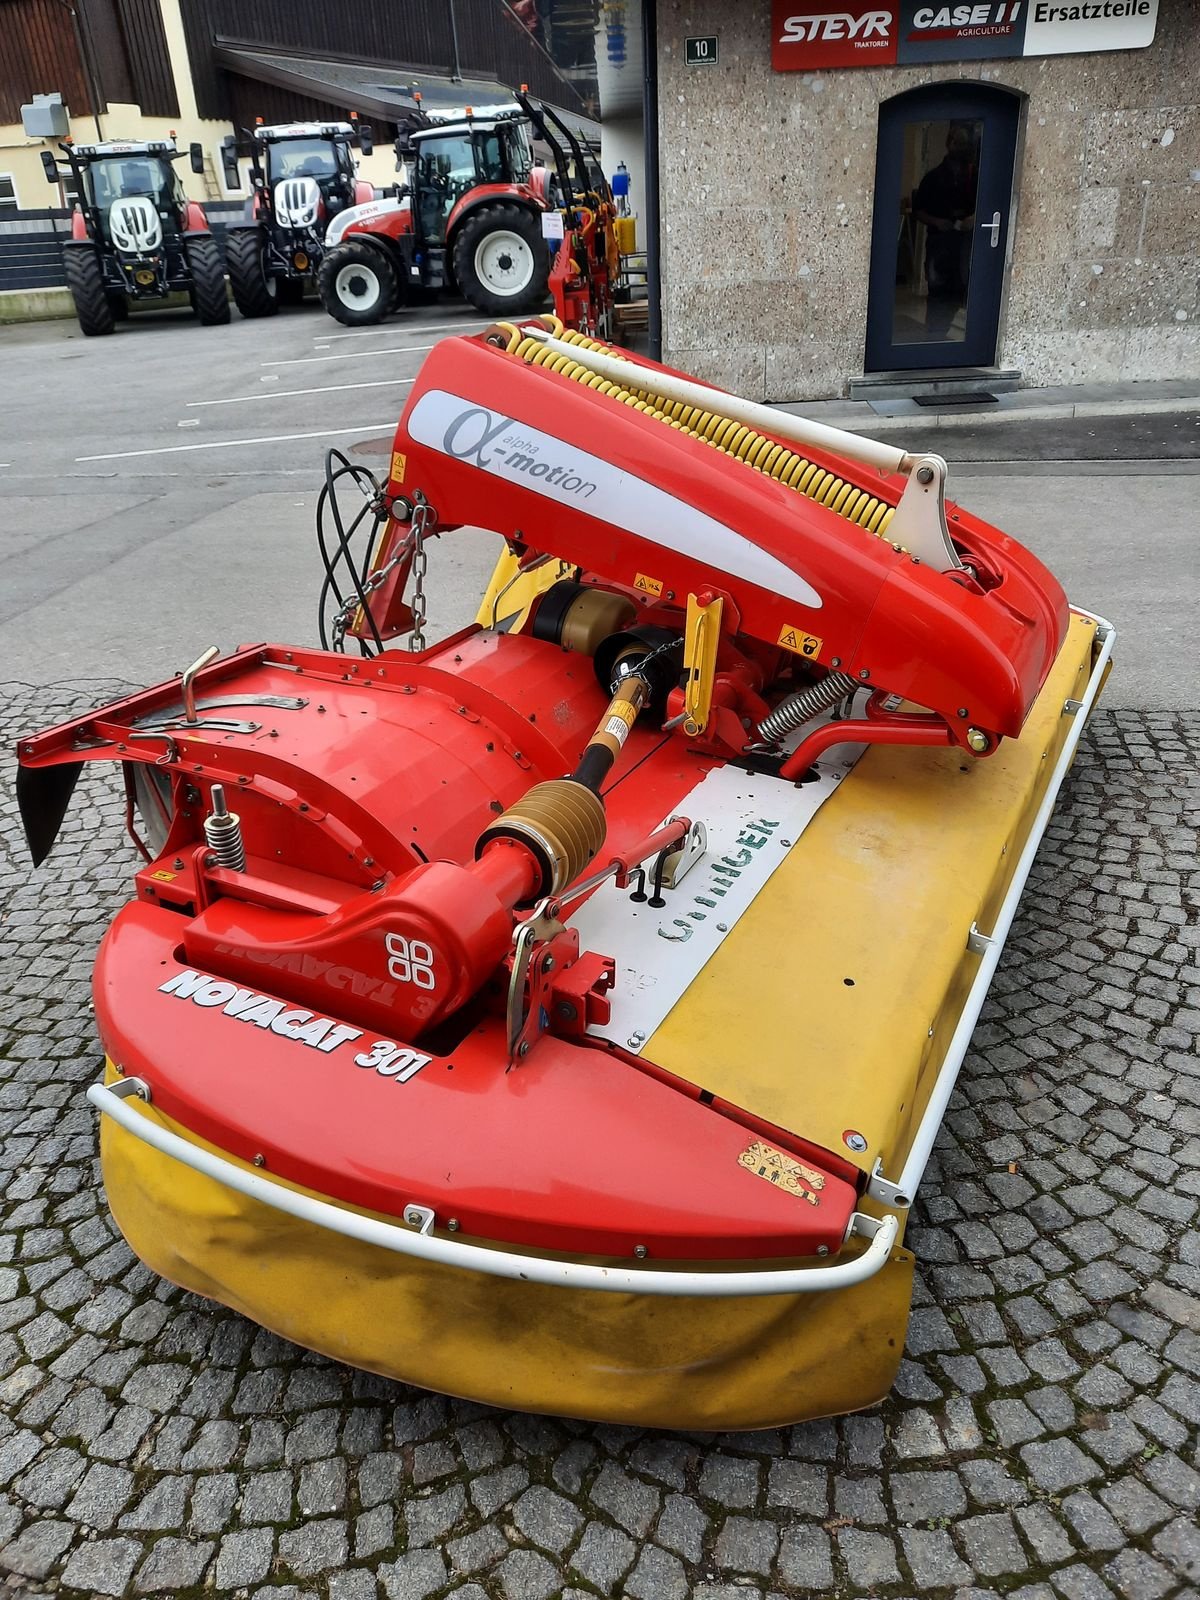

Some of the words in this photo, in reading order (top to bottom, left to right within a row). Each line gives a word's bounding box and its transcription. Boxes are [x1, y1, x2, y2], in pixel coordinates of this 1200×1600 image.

[913, 4, 991, 29] CASE
[1034, 0, 1150, 23] Ersatzteile
[779, 10, 893, 43] STEYR
[956, 26, 1011, 37] AGRICULTURE
[695, 40, 708, 57] 10
[854, 40, 889, 49] TRAKTOREN
[502, 434, 540, 455] alpha
[158, 969, 363, 1053] NOVACAT
[354, 1041, 433, 1083] 301
